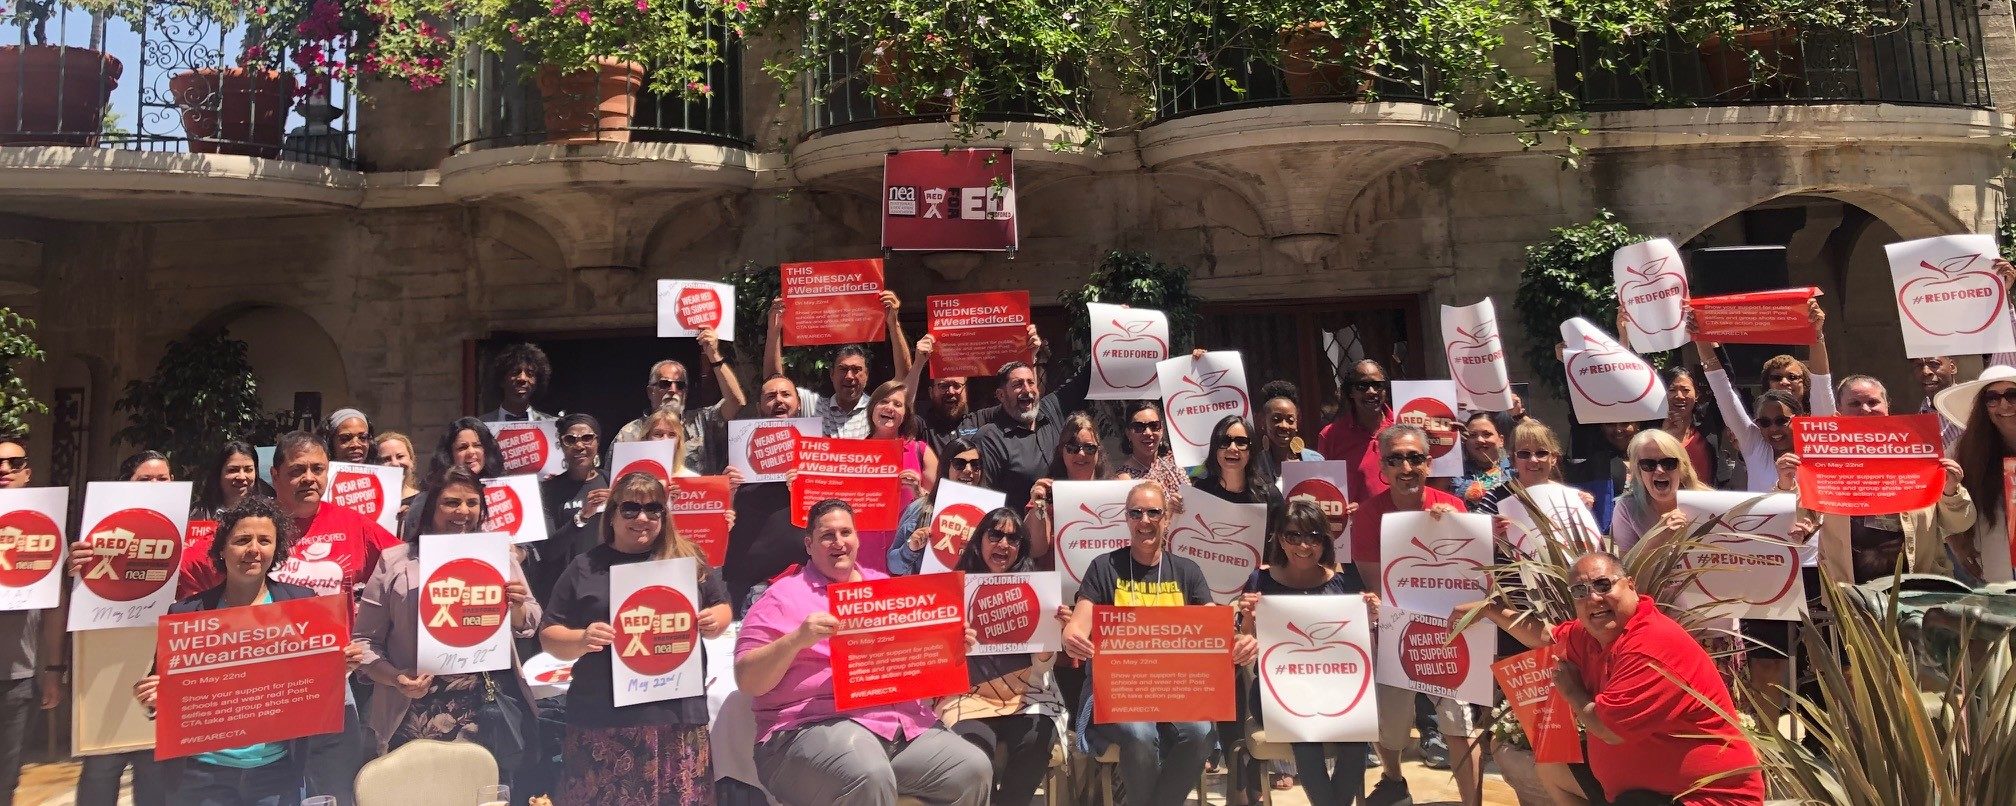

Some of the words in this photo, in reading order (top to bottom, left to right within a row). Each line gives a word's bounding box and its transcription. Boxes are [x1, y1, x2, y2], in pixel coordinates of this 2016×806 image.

[889, 186, 915, 200] nea
[962, 187, 1013, 220] ED
[786, 267, 812, 276] THIS
[786, 274, 862, 285] WEDNESDAY
[787, 282, 878, 294] #WearRedforED
[1627, 286, 1680, 306] #REDFORED
[1913, 287, 1992, 305] #REDFORED
[933, 300, 960, 308] THIS
[933, 306, 1008, 318] WEDNESDAY
[934, 314, 1024, 327] #WearRedforED
[1102, 349, 1159, 359] #REDFORED
[1579, 362, 1644, 376] #REDFORED
[1176, 400, 1239, 416] #REDFORED
[1404, 416, 1422, 424] RED
[1800, 422, 1839, 430] THIS
[754, 434, 775, 448] WEAR
[776, 430, 790, 440] RED
[1801, 432, 1910, 443] WEDNESDAY
[800, 441, 830, 450] THIS
[1803, 444, 1934, 454] #WearRedforED
[754, 450, 764, 460] TO
[760, 454, 786, 470] PUBLIC
[800, 452, 882, 464] WEDNESDAY
[799, 462, 898, 474] #WearRedforED
[335, 480, 357, 494] WEAR
[335, 496, 345, 506] TO
[345, 488, 376, 505] SUPPORT
[941, 518, 962, 532] RED
[26, 534, 56, 552] ED
[94, 538, 126, 550] RED
[138, 538, 175, 560] ED
[1068, 539, 1131, 550] #REDFORE
[1178, 544, 1250, 568] #REDFORED
[126, 570, 146, 580] nea
[278, 574, 340, 588] Students
[1398, 577, 1481, 590] #REDFORED
[432, 587, 460, 598] RED
[470, 586, 502, 606] ED
[836, 587, 874, 602] THIS
[978, 594, 1004, 610] WEAR
[1004, 588, 1022, 601] RED
[836, 594, 937, 616] WEDNESDAY
[838, 605, 958, 630] #WearRedforED
[978, 613, 992, 626] TO
[992, 600, 1028, 622] SUPPORT
[1100, 612, 1136, 622] THIS
[169, 617, 220, 635] THIS
[462, 616, 481, 626] nea
[624, 616, 650, 627] RED
[660, 612, 690, 634] ED
[984, 619, 1017, 638] PUBLIC
[1018, 616, 1028, 628] ED
[169, 621, 310, 652] WEDNESDAY
[1100, 624, 1203, 636] WEDNESDAY
[1100, 638, 1226, 650] #WearRedforED
[1409, 633, 1434, 646] WEAR
[168, 633, 336, 668] #WearRedforED
[654, 644, 672, 654] nea
[1408, 649, 1420, 661] TO
[1421, 646, 1458, 660] SUPPORT
[1275, 662, 1358, 675] #REDFORED
[1415, 662, 1445, 676] PUBLIC
[1446, 662, 1458, 674] ED
[1501, 658, 1536, 676] THIS
[200, 677, 220, 685] May
[222, 672, 246, 680] 22nd
[628, 679, 648, 692] May
[182, 694, 209, 703] Show
[212, 691, 233, 700] your
[235, 685, 270, 696] support
[287, 678, 315, 688] public
[182, 700, 218, 712] schools
[220, 698, 238, 706] and
[240, 694, 264, 703] wear
[266, 690, 284, 698] red!
[287, 687, 308, 696] Post
[182, 710, 212, 720] selfies
[235, 703, 262, 712] group
[264, 698, 290, 707] shots
[181, 720, 202, 728] CTA
[204, 717, 224, 725] take
[227, 712, 256, 722] action
[180, 729, 247, 744] #WEARECTA
